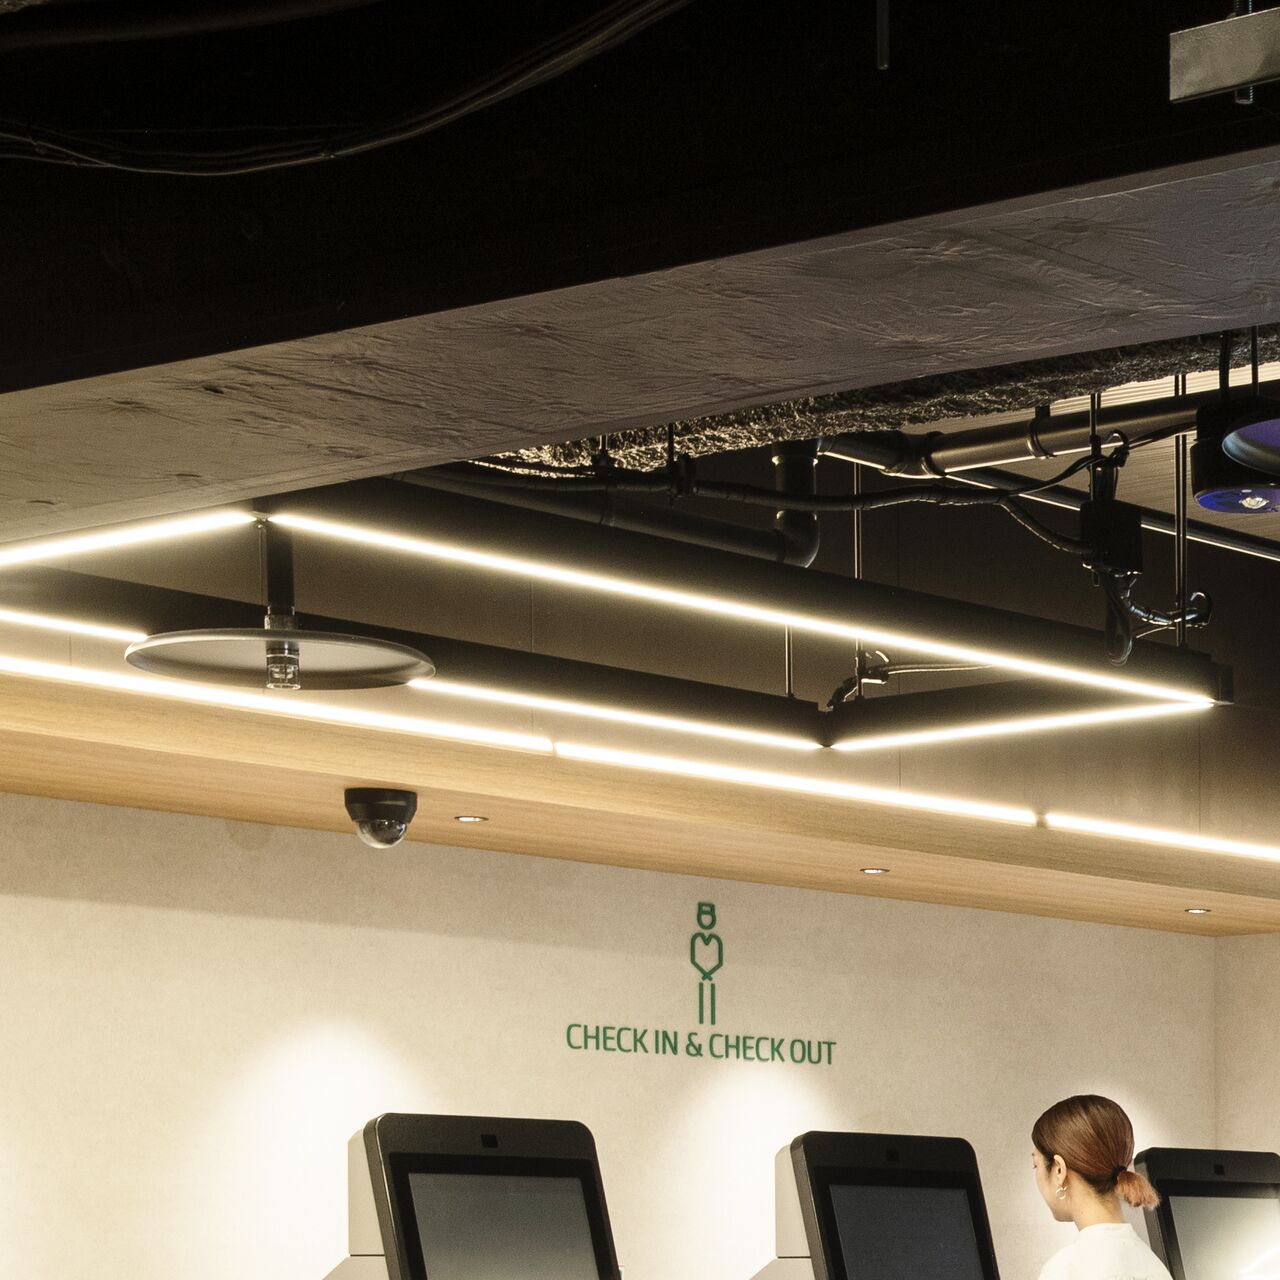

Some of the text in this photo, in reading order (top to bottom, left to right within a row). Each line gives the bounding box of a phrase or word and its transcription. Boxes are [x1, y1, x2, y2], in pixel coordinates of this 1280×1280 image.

[565, 1022, 837, 1065] CHECK IN & CHECK OUT
